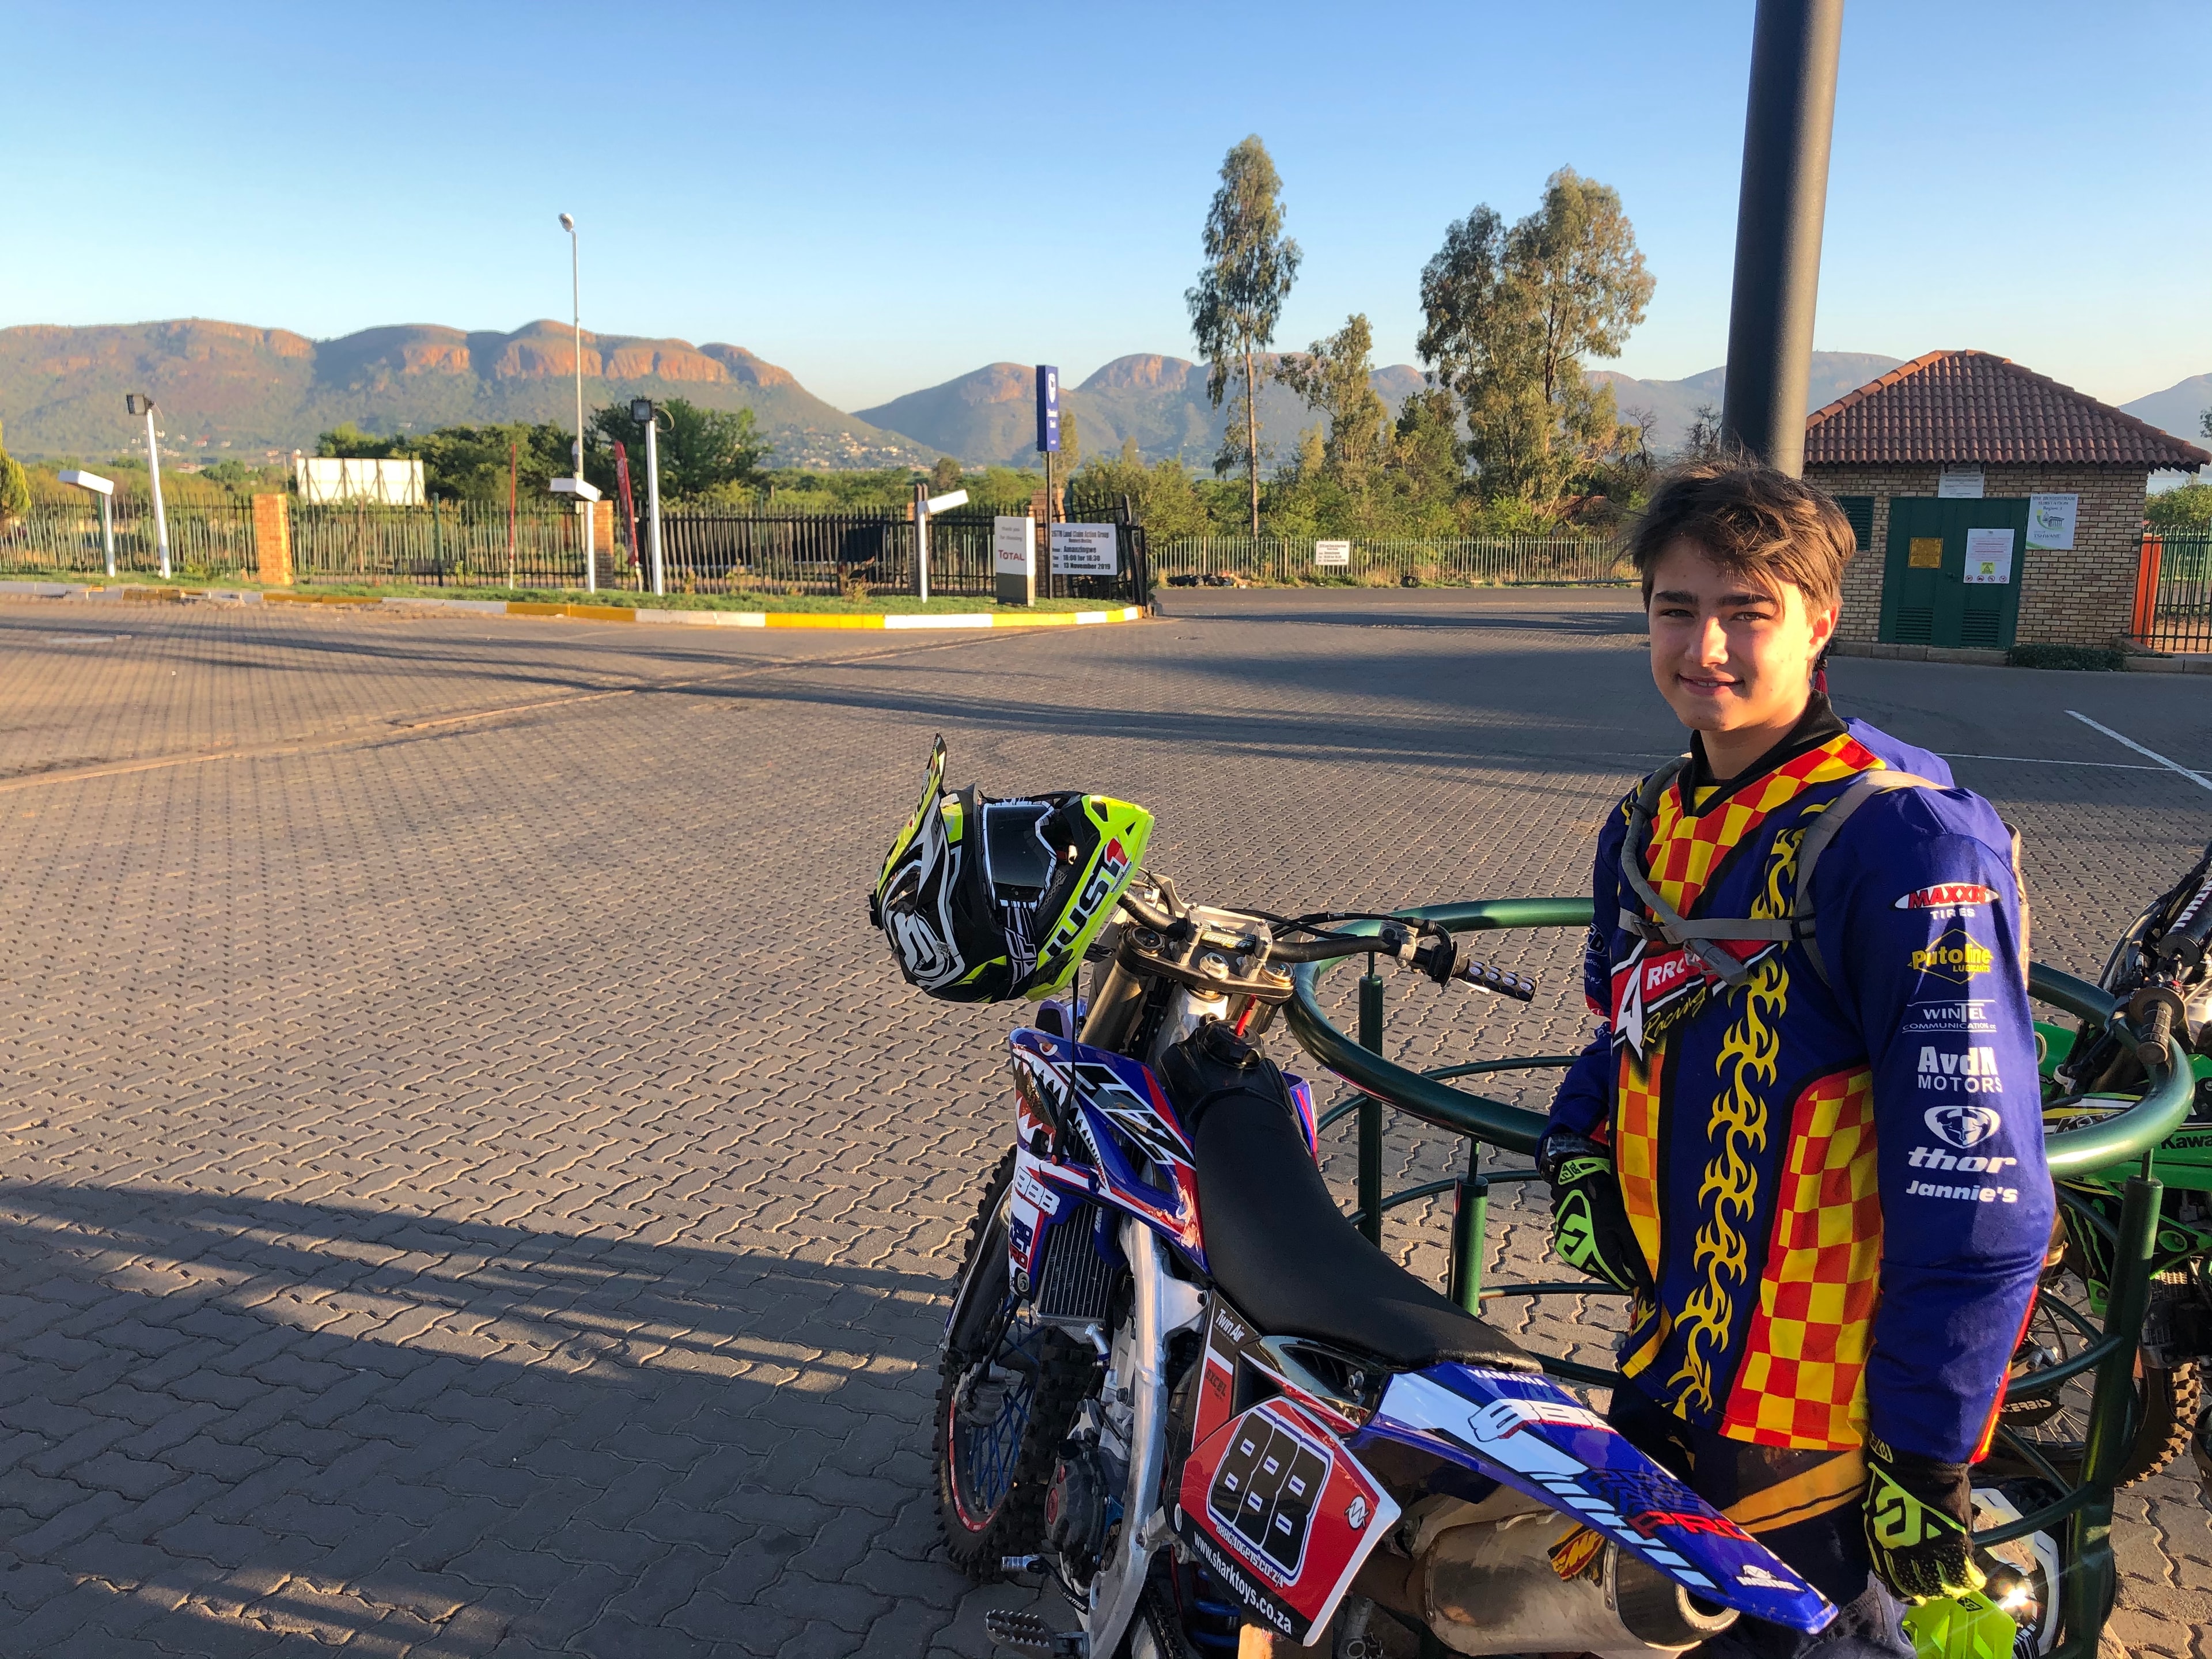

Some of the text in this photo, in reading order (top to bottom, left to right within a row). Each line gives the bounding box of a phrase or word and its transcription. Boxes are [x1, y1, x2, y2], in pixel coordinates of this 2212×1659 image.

[998, 549, 1025, 561] TOTAL
[1908, 885, 1987, 909] MAXXIS
[1930, 908, 1975, 920] TIRES
[1641, 986, 1707, 1048] Racing
[1922, 1003, 1987, 1022] WINTEL
[1918, 1074, 2003, 1093] MOTORS
[1908, 1146, 2017, 1174] thor
[1015, 1166, 1060, 1216] 888
[1906, 1180, 2018, 1203] Jannie's
[1215, 1308, 1245, 1343] Twin Air
[1467, 1369, 1551, 1388] YAMAHA
[1207, 1408, 1332, 1578] 888
[1194, 1531, 1292, 1635] www.sharktoys.co.za
